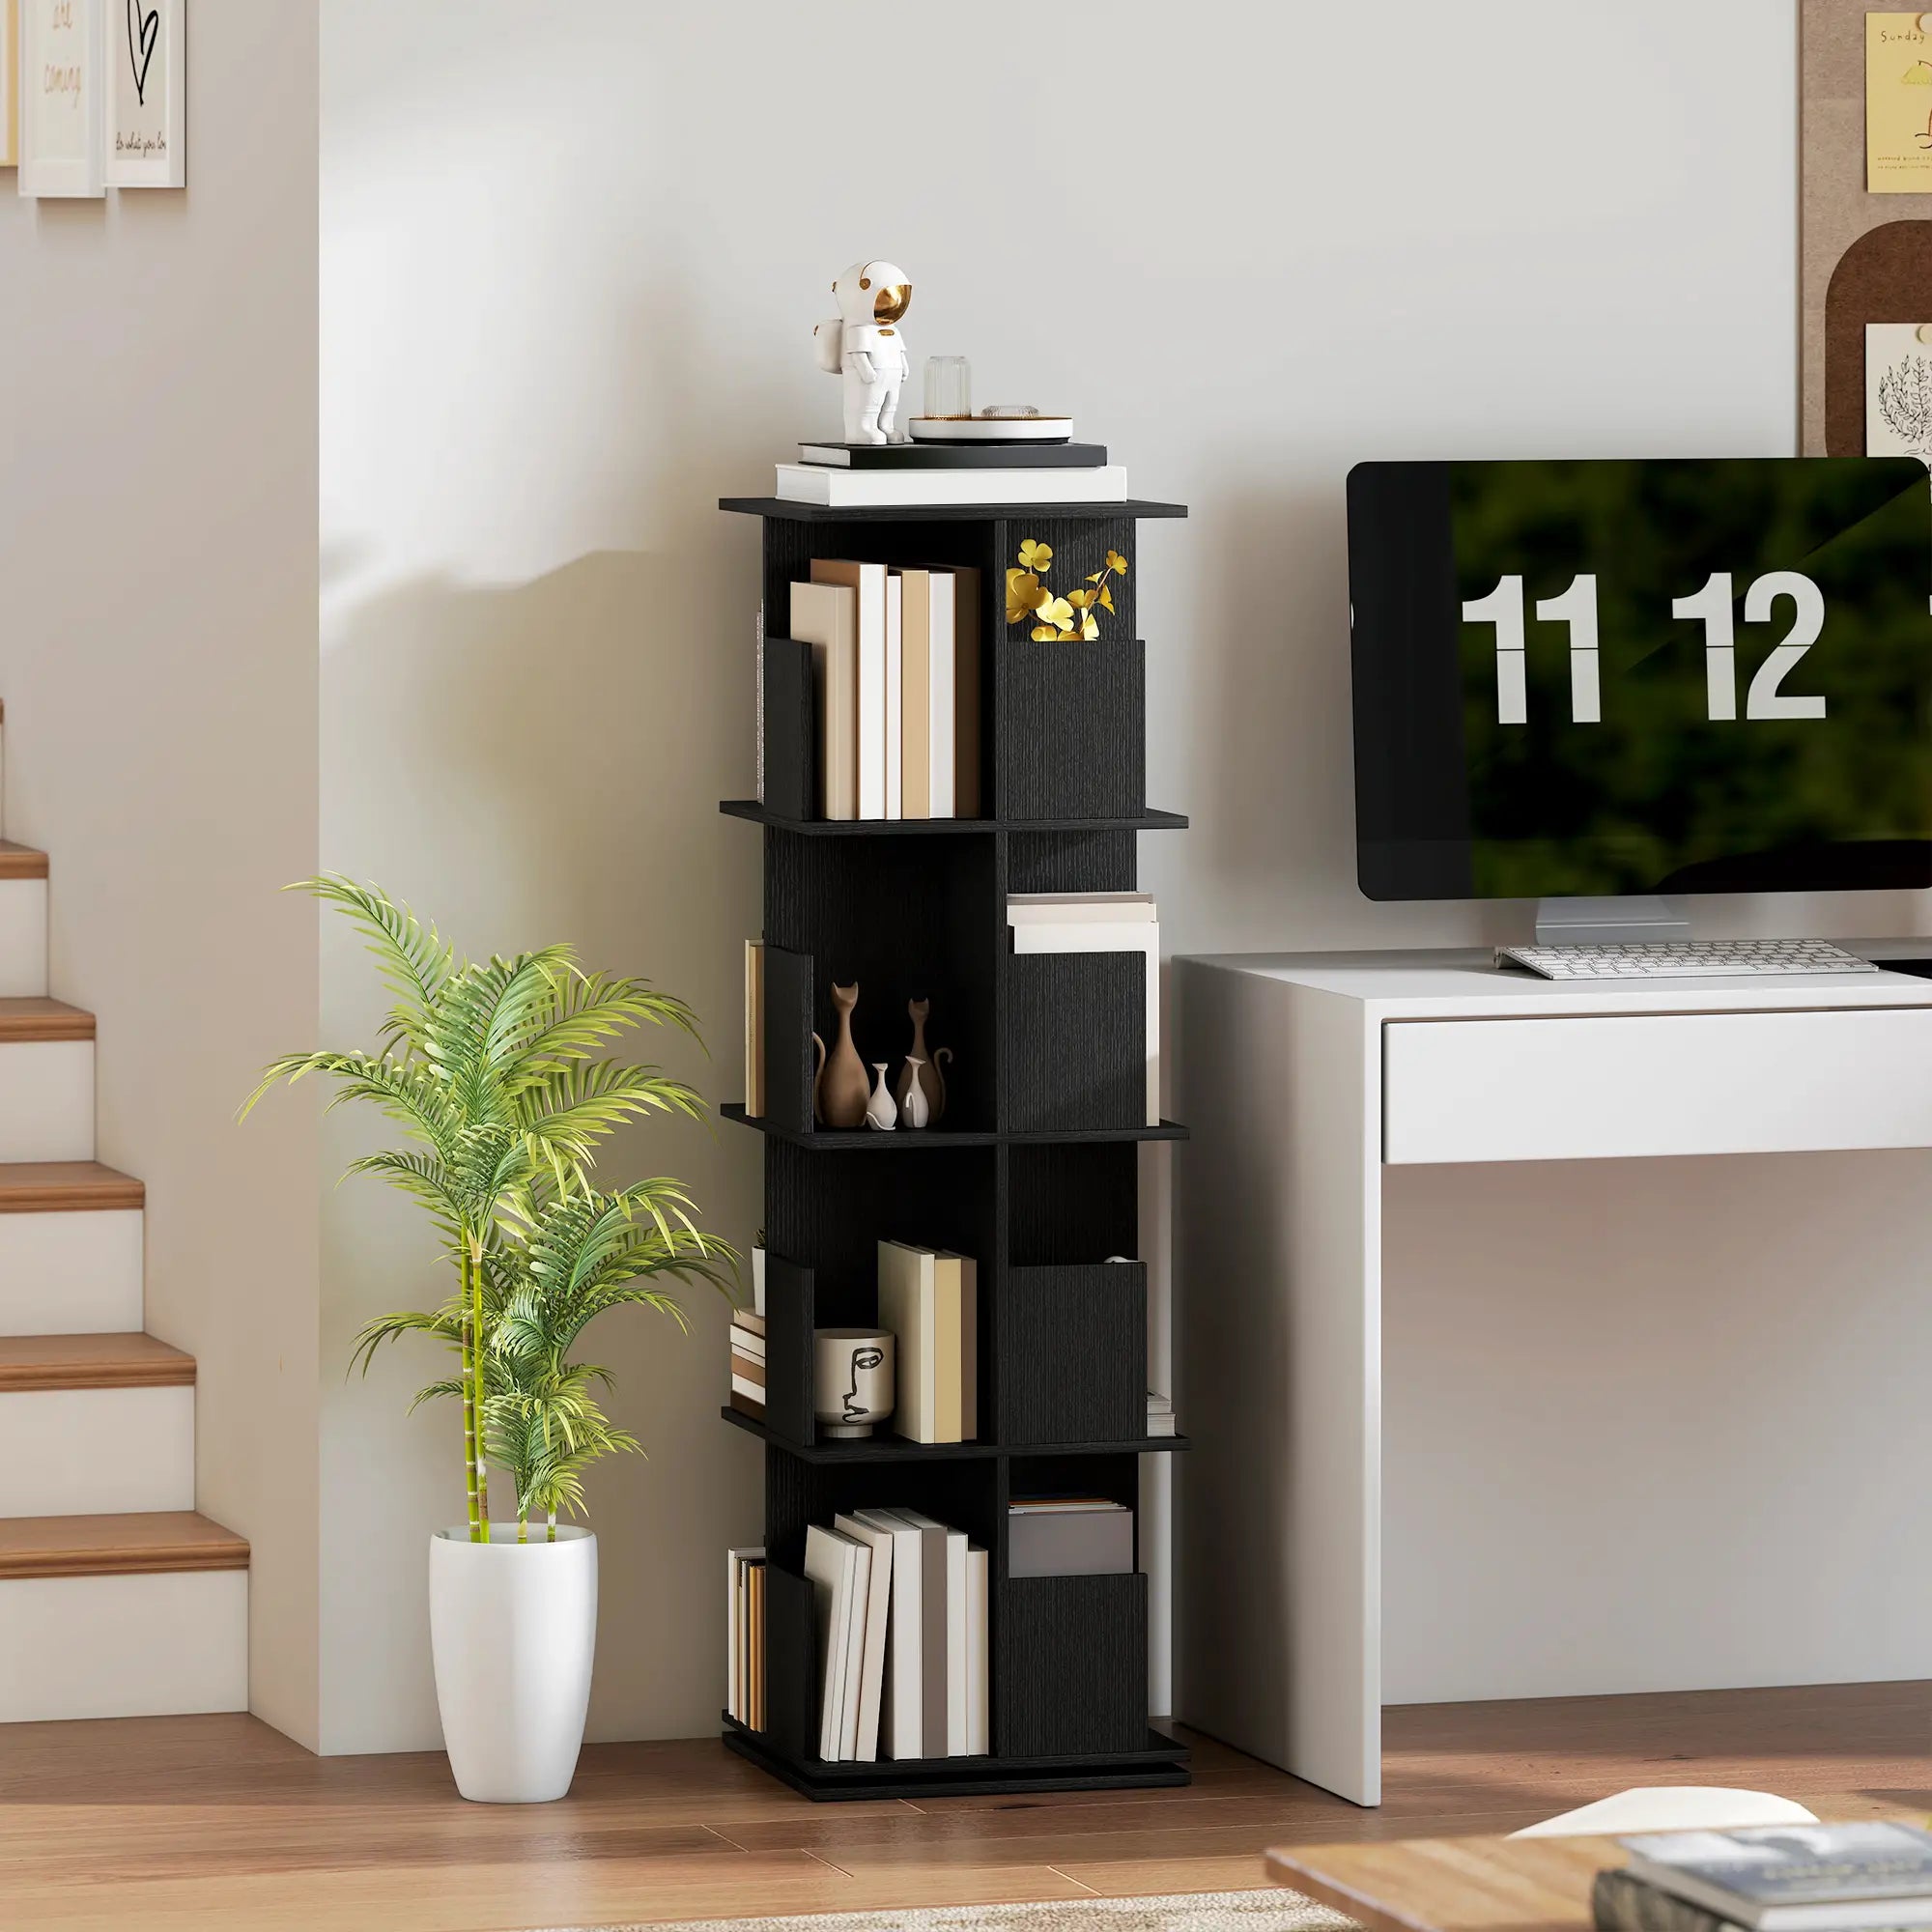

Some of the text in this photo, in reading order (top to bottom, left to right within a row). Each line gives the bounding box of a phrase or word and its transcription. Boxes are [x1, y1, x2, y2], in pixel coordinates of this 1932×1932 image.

[1881, 30, 1924, 44] Sunday
[1462, 571, 1827, 724] 11 12
